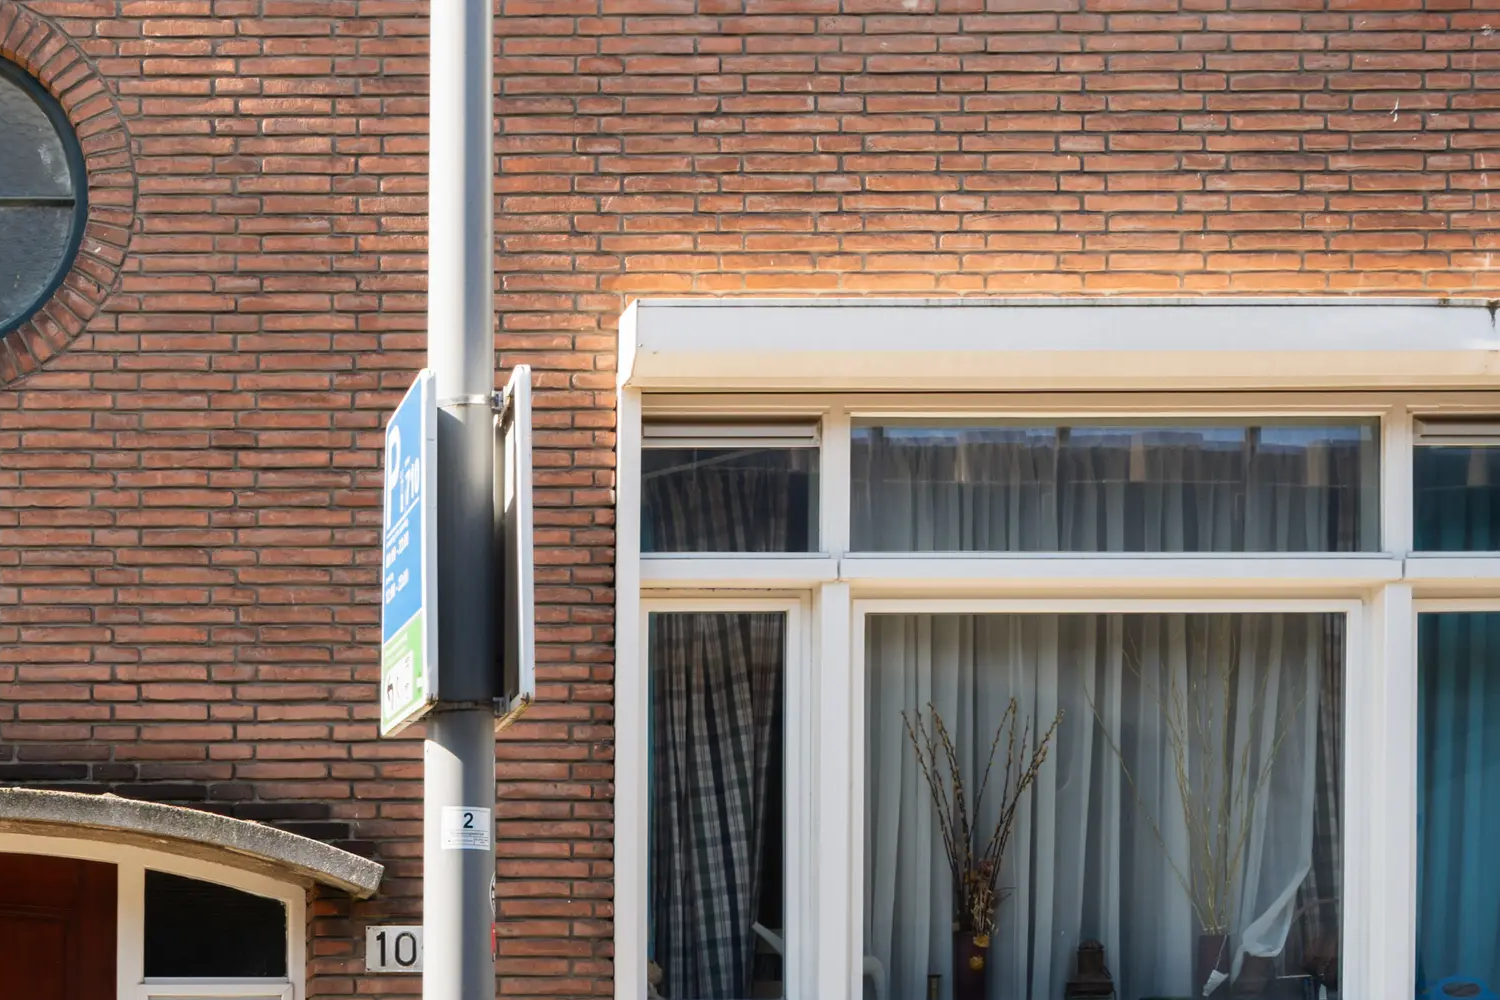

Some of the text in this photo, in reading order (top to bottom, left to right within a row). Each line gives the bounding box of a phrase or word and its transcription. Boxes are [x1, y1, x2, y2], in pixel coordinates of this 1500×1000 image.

[386, 424, 401, 530] P
[463, 812, 474, 829] 2
[376, 931, 417, 967] 10
